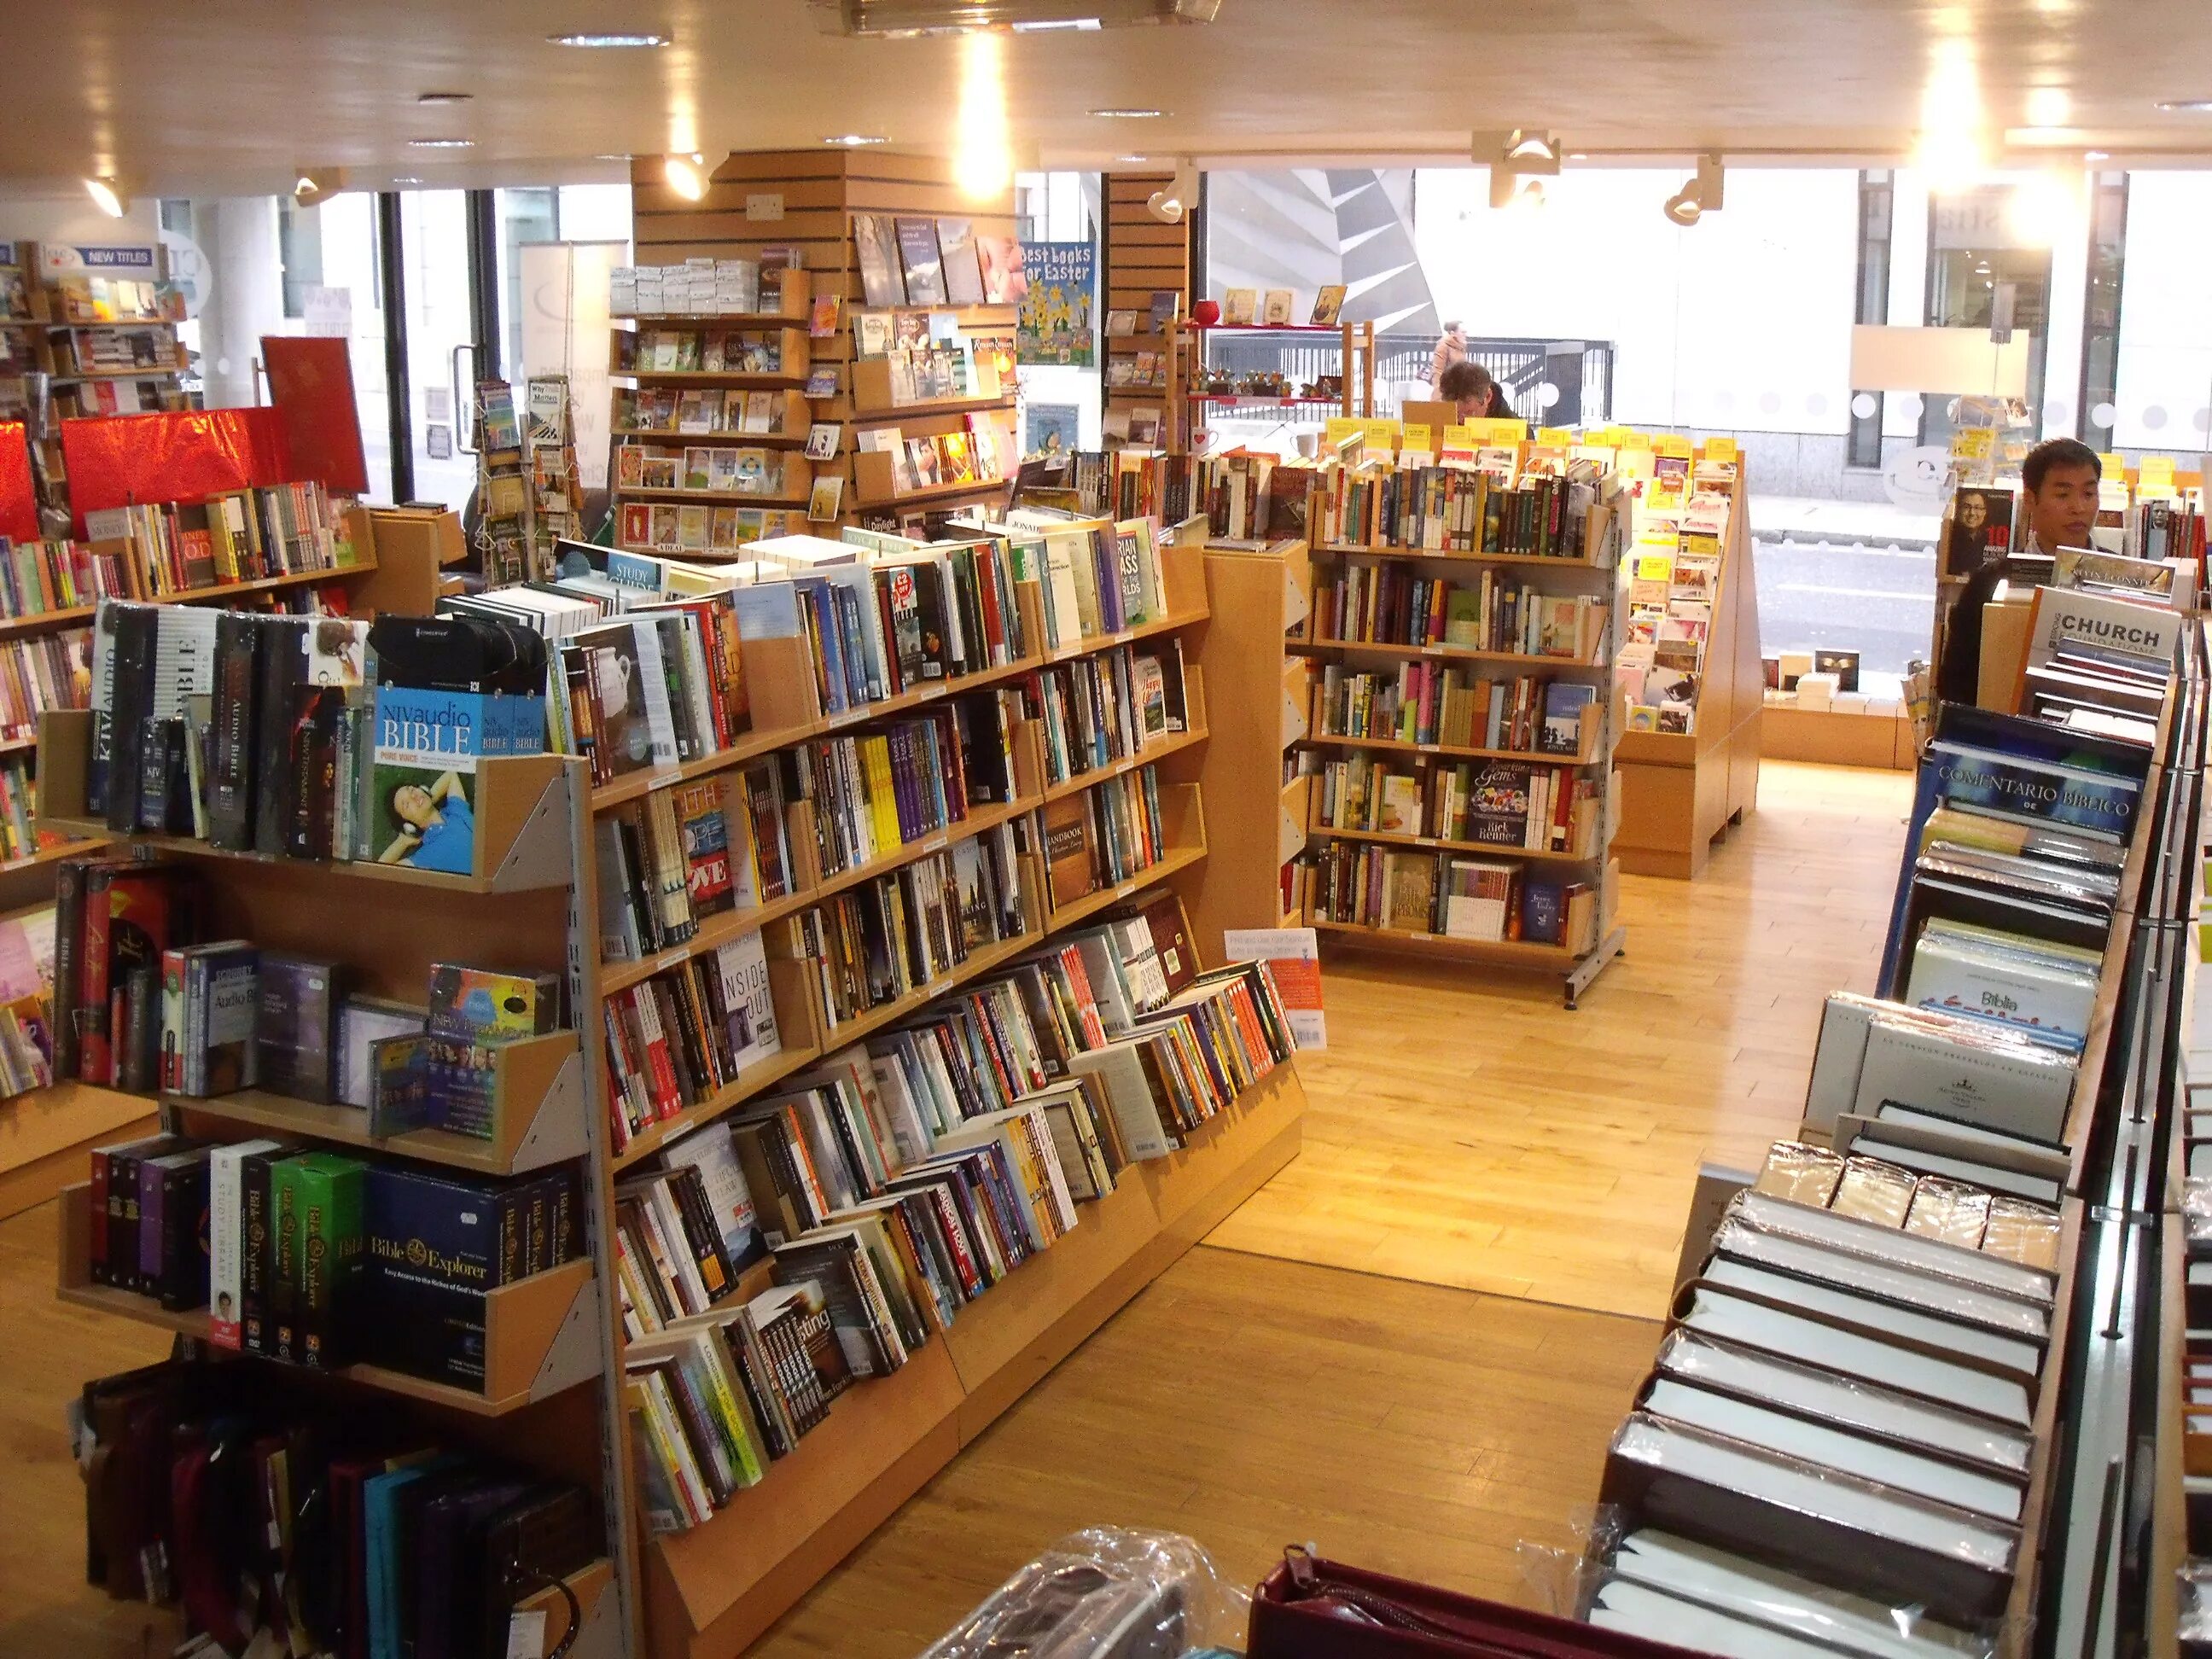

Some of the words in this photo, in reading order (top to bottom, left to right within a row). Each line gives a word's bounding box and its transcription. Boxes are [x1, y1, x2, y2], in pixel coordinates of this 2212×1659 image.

[89, 251, 114, 262] NEW
[117, 250, 148, 262] TITLES
[1045, 264, 1091, 281] Easter
[871, 517, 896, 532] Daylight
[1987, 525, 2009, 544] 10
[1117, 538, 1137, 556] RIAN
[616, 562, 649, 583] STUDY
[1119, 555, 1139, 576] ASS
[899, 583, 911, 594] OFF
[1121, 583, 1141, 597] RLDS
[2061, 614, 2160, 648] CHURCH
[383, 719, 471, 755] BIBLE
[483, 737, 508, 749] BIBLE
[515, 737, 539, 749] BIBLE
[1475, 766, 1517, 788] Gems
[1938, 766, 2058, 802] COMENTARIO
[683, 783, 717, 812] ITH
[1478, 827, 1517, 842] Renner
[1487, 821, 1509, 833] Rick
[725, 960, 767, 1001] NSIDE
[746, 987, 771, 1020] OUT
[1981, 991, 2017, 1012] Biblia
[938, 1185, 958, 1228] RADICAL
[952, 1227, 968, 1255] LOVE
[217, 1229, 227, 1281] LIBRARY
[370, 1237, 406, 1260] Bible
[427, 1249, 488, 1279] Explorer
[384, 1267, 398, 1278] Easy
[397, 1271, 415, 1282] Access
[421, 1275, 431, 1284] the
[431, 1277, 449, 1289] Riches
[449, 1281, 457, 1290] of
[456, 1283, 473, 1295] God's
[472, 1287, 486, 1297] Word
